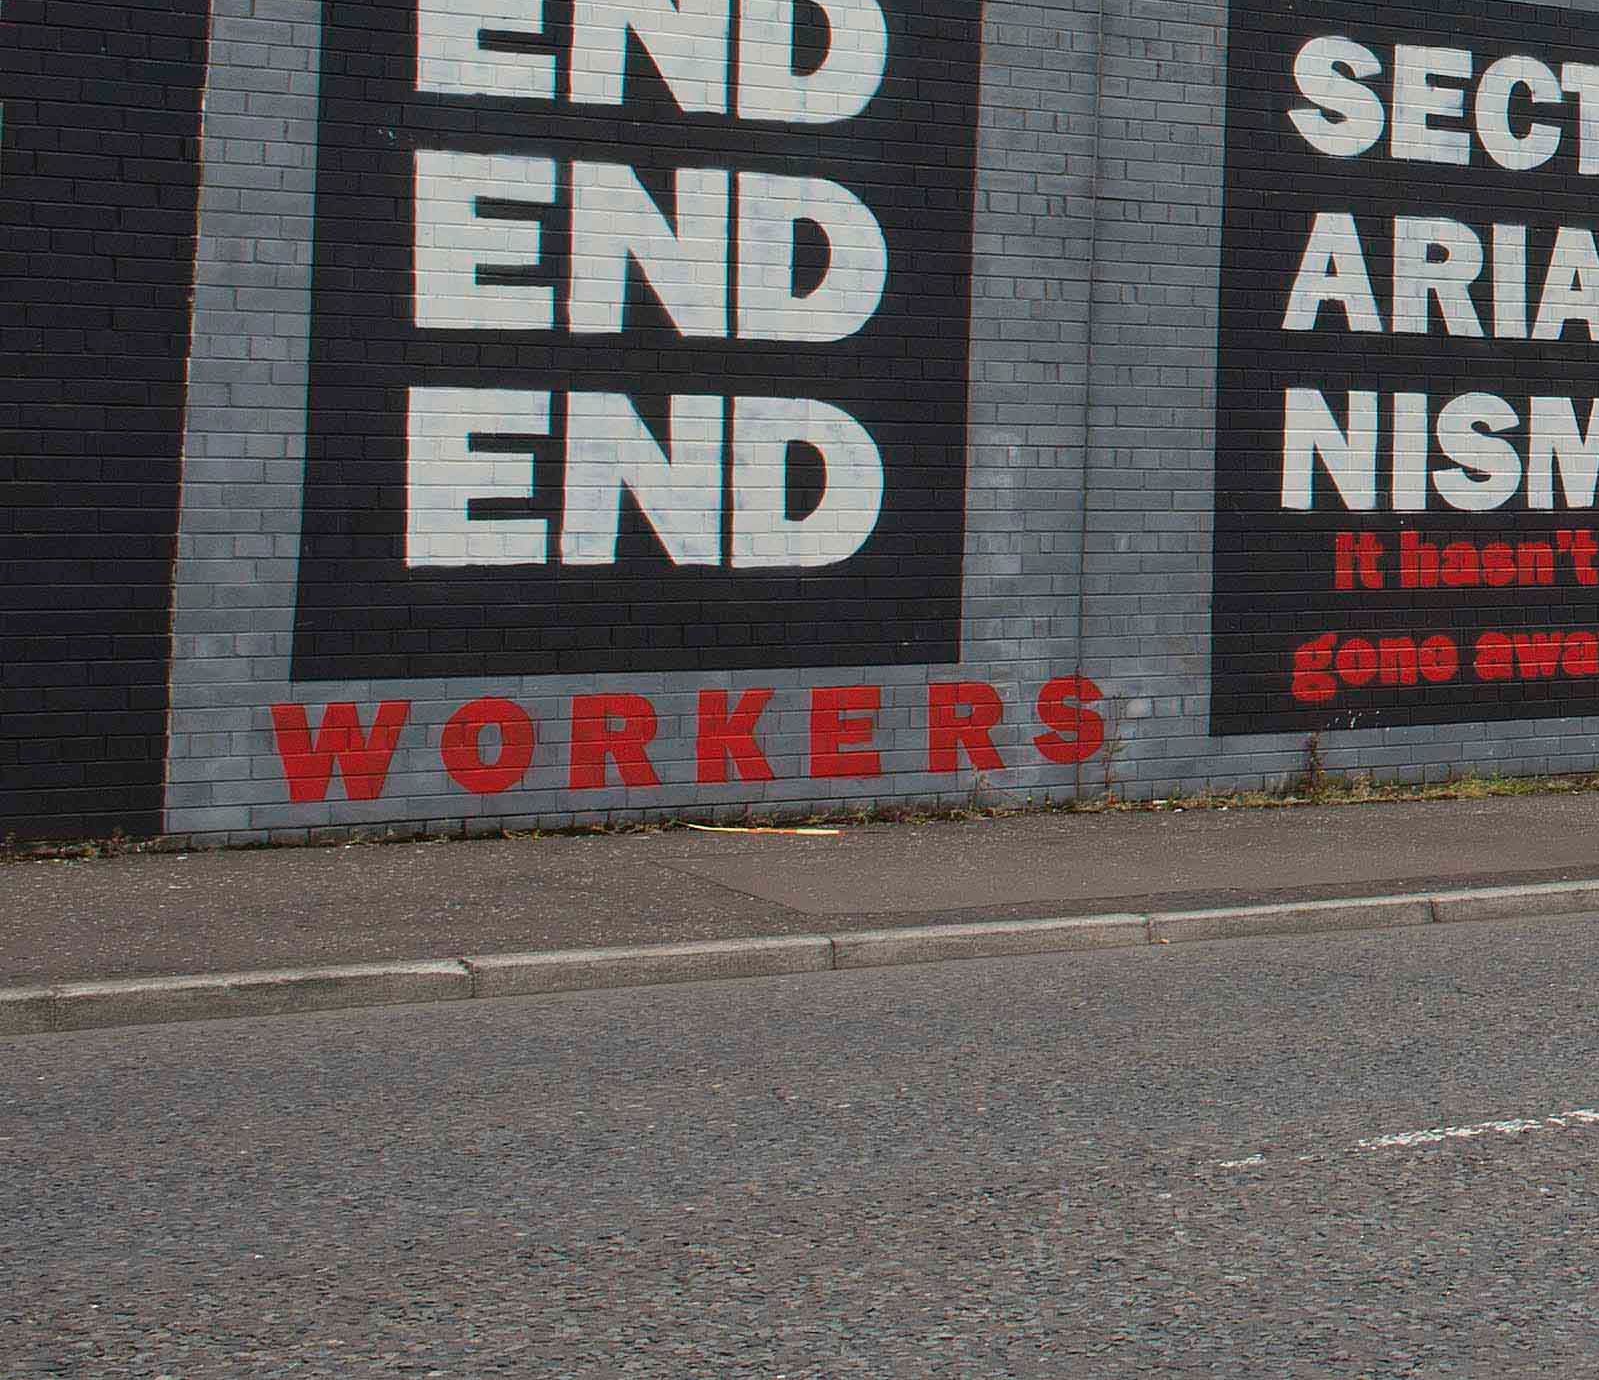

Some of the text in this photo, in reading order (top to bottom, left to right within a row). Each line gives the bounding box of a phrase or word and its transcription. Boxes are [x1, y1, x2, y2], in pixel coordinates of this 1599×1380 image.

[412, 147, 889, 343] END
[405, 384, 886, 570] END
[1400, 529, 1598, 588] hasn't
[1291, 632, 1458, 701] gone
[268, 674, 1107, 806] WORKERS
